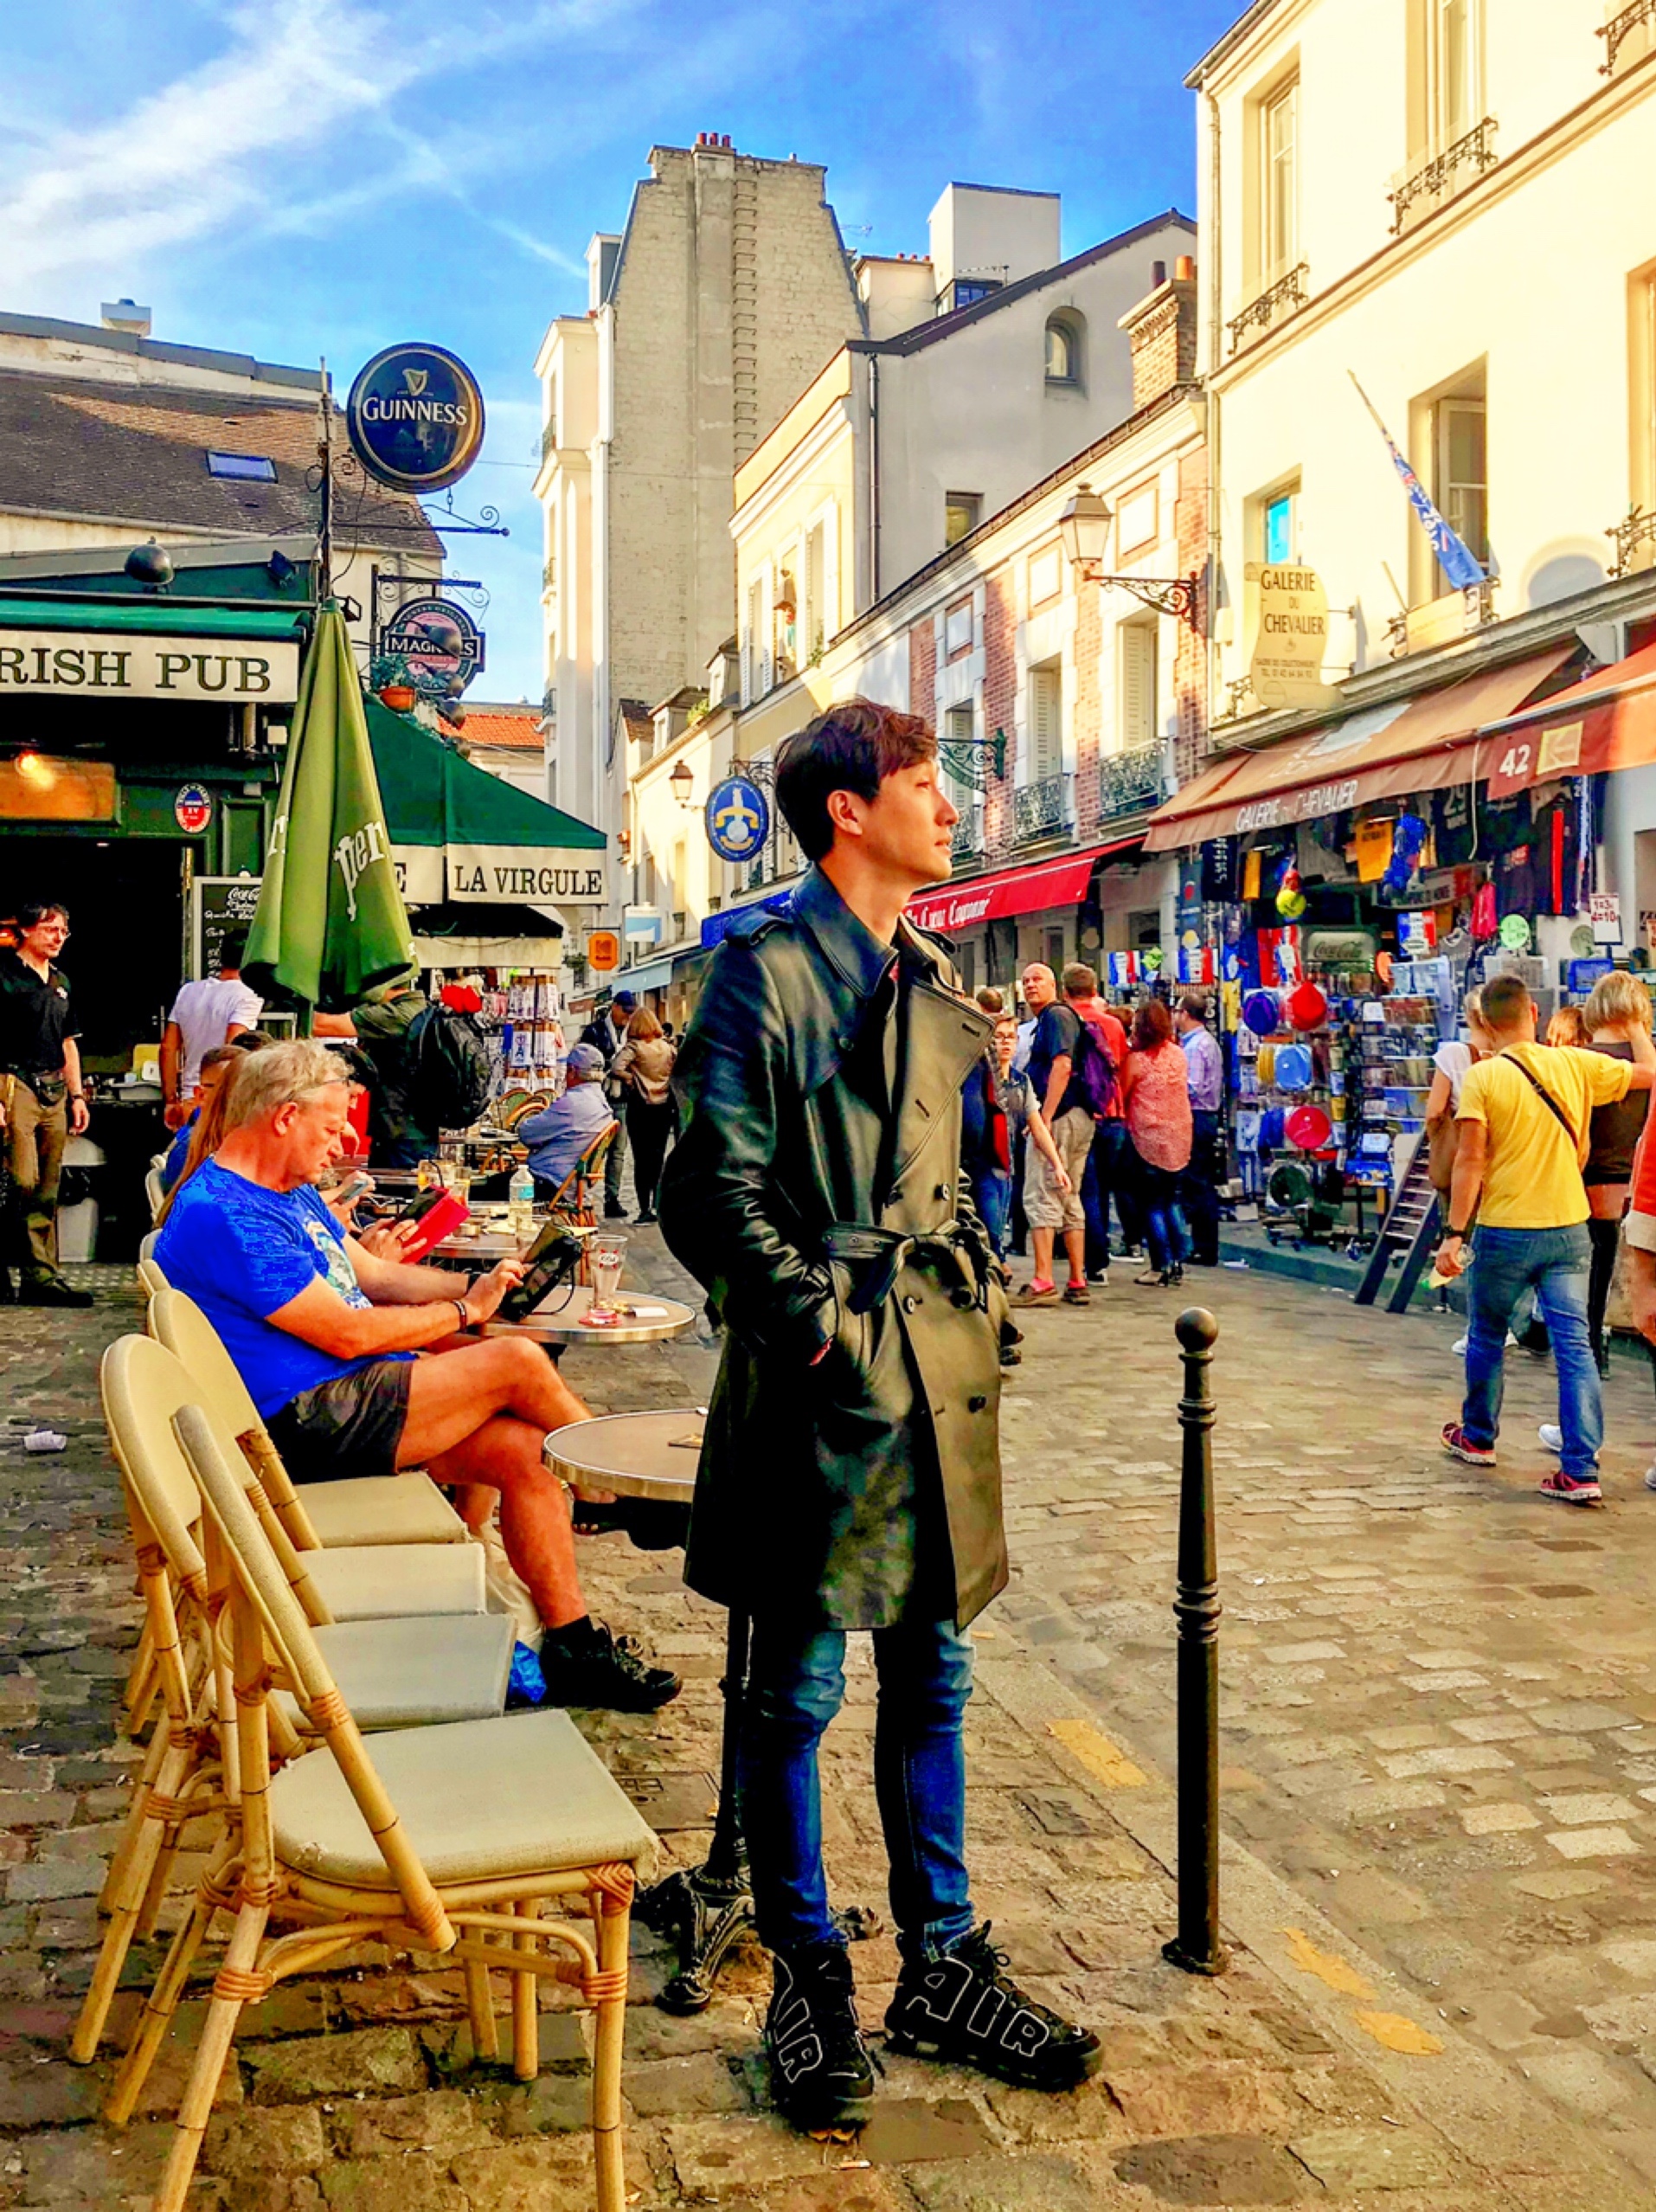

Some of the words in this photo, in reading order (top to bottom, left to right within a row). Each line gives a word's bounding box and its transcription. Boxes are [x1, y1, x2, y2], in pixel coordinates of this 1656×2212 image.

[362, 396, 467, 426] GUINNESS
[1261, 569, 1315, 591] GALERIE
[1264, 613, 1325, 634] CHEVALIER
[0, 647, 132, 686] RISH
[155, 653, 271, 692] PUB
[1499, 744, 1531, 776] 42
[1235, 798, 1281, 832] GALERIE
[454, 865, 487, 892] LA
[494, 867, 601, 896] VIRGULE
[904, 1957, 1050, 2058] AIR
